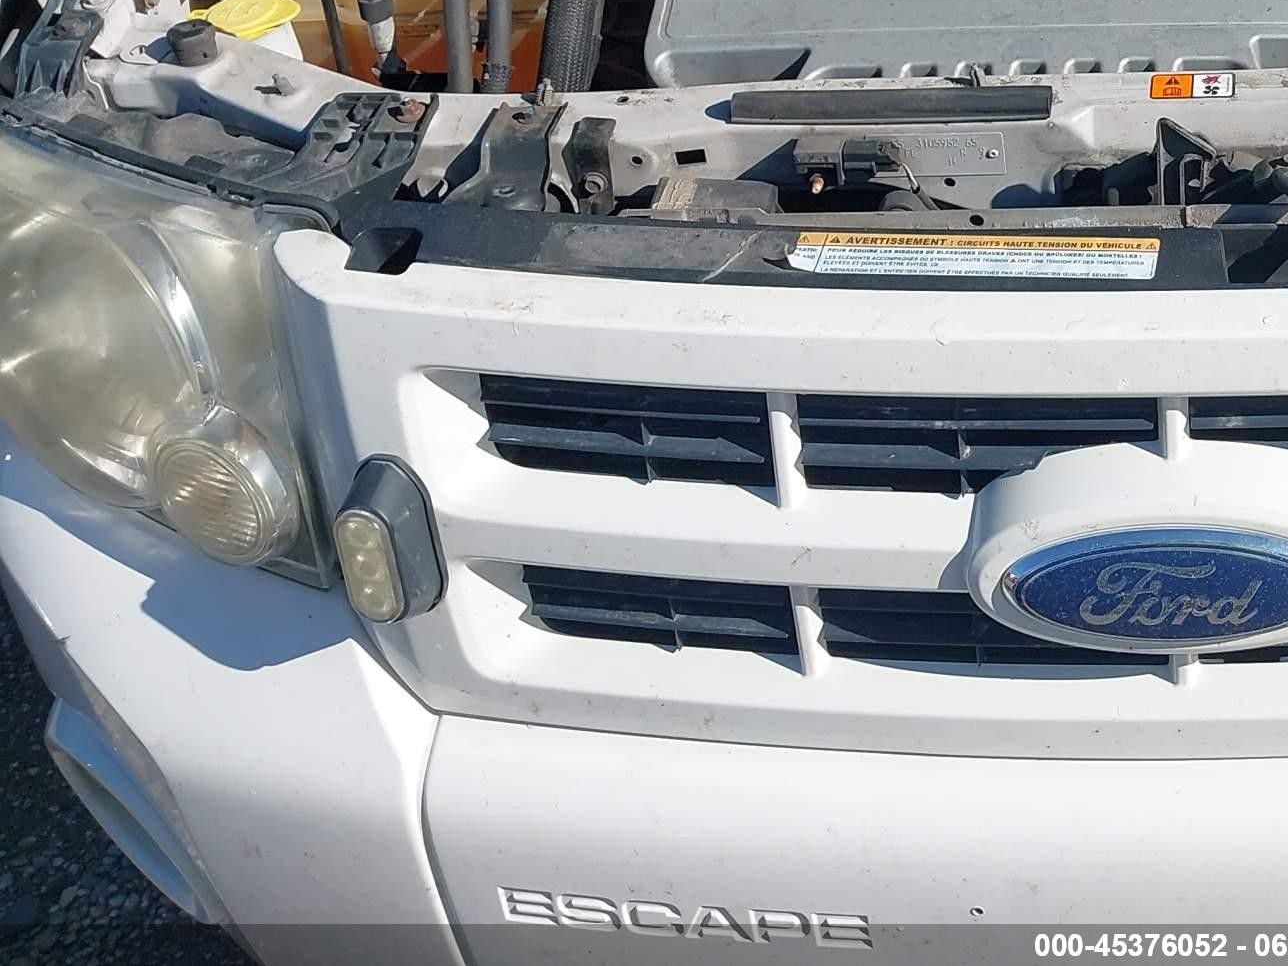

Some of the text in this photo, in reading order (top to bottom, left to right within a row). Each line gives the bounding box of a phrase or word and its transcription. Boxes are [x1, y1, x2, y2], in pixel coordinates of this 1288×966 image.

[845, 236, 948, 246] AVERTISSEMENT
[1037, 241, 1078, 249] TENSION
[1080, 561, 1263, 626] Ford
[497, 885, 873, 949] ESCAPE
